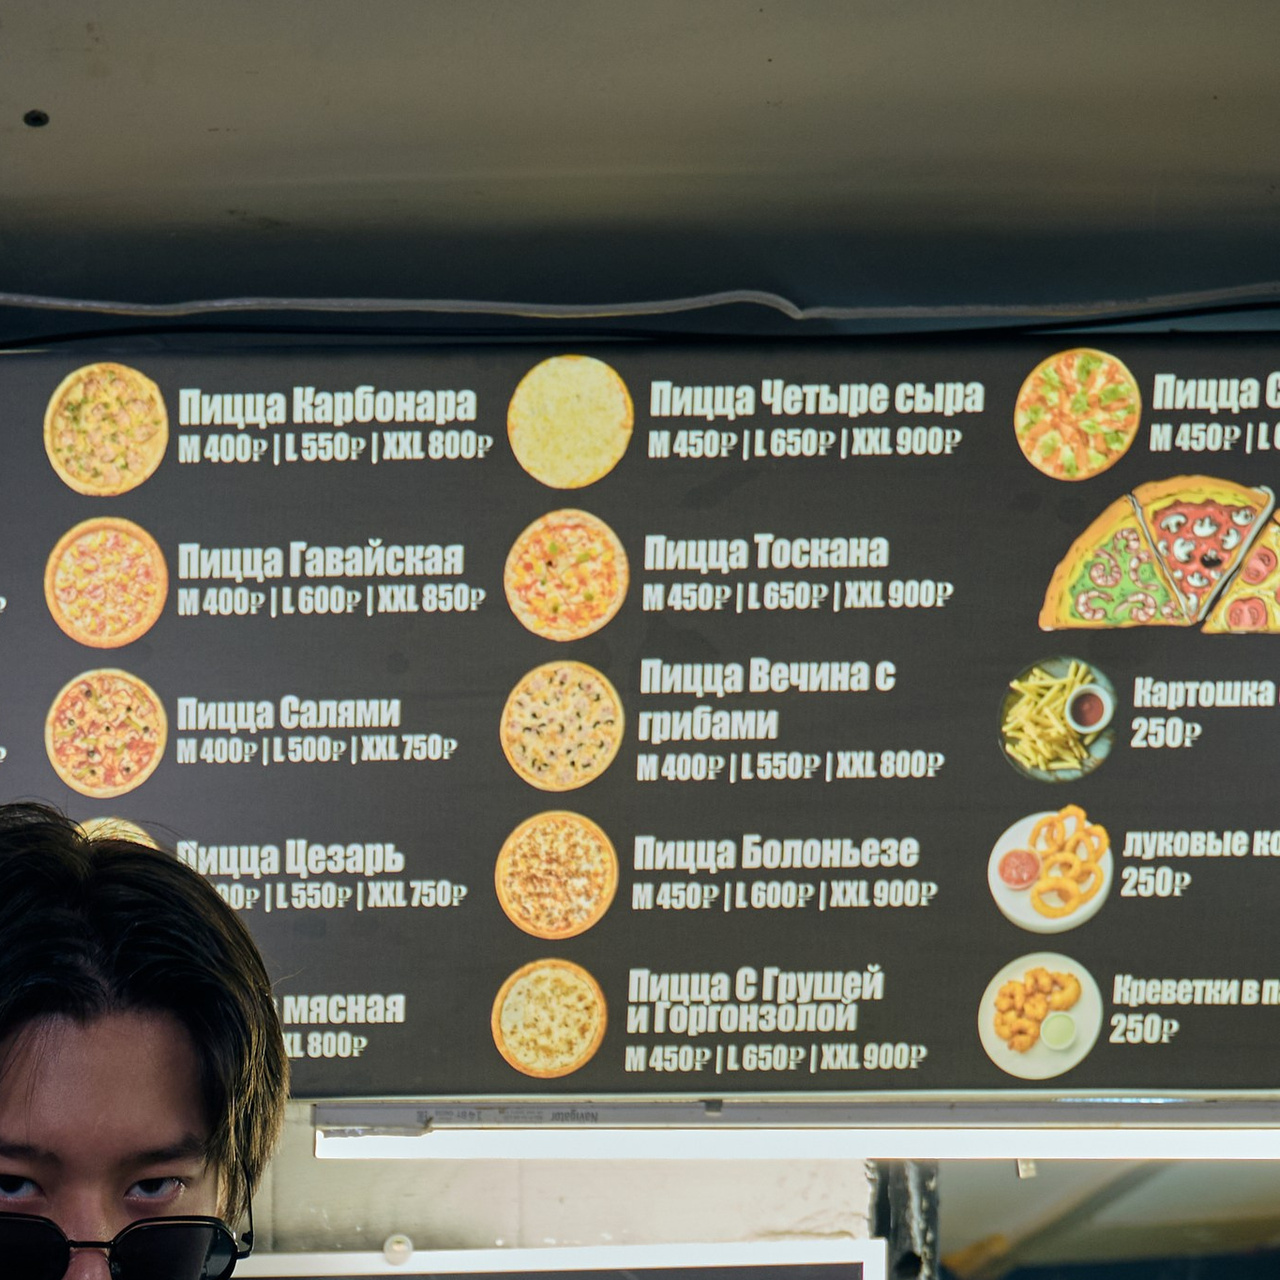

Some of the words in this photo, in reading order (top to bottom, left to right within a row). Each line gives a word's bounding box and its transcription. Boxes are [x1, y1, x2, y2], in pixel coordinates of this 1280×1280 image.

[179, 388, 287, 430] Пицца
[292, 385, 477, 427] Карбонара
[650, 380, 756, 421] Пицца
[761, 379, 890, 418] Четыре
[894, 381, 985, 417] сыра
[1152, 373, 1260, 414] Пицца
[178, 434, 201, 464] M
[284, 433, 299, 462] L
[382, 431, 426, 460] XXL
[647, 430, 671, 458] M
[754, 429, 768, 457] L
[851, 427, 893, 456] XXL
[1149, 423, 1173, 452] M
[1257, 422, 1271, 450] L
[178, 543, 284, 583] Пицца
[289, 538, 464, 578] Гавайская
[644, 534, 749, 575] Пицца
[753, 533, 889, 569] Тоскана
[640, 658, 744, 698] Пицца
[749, 657, 870, 693] Вечина
[1133, 676, 1276, 710] Картошка
[177, 697, 275, 734] Пицца
[279, 694, 401, 729] Салями
[638, 705, 779, 745] грибами
[176, 738, 198, 764] M
[272, 736, 286, 763] L
[360, 734, 400, 761] XXL
[636, 753, 659, 781] M
[741, 752, 754, 780] L
[836, 750, 878, 779] XXL
[285, 838, 405, 879] Цезарь
[633, 835, 737, 875] Пицца
[741, 833, 920, 869] Болоньезе
[1122, 830, 1249, 860] луковые
[628, 968, 730, 1003] Пицца
[762, 963, 885, 1002] Грушей
[1112, 974, 1240, 1007] Креветки
[283, 993, 406, 1024] мясная
[653, 996, 858, 1036] Горгонзолой
[624, 1045, 647, 1072] M
[726, 1044, 740, 1071] L
[820, 1043, 861, 1070] XXL
